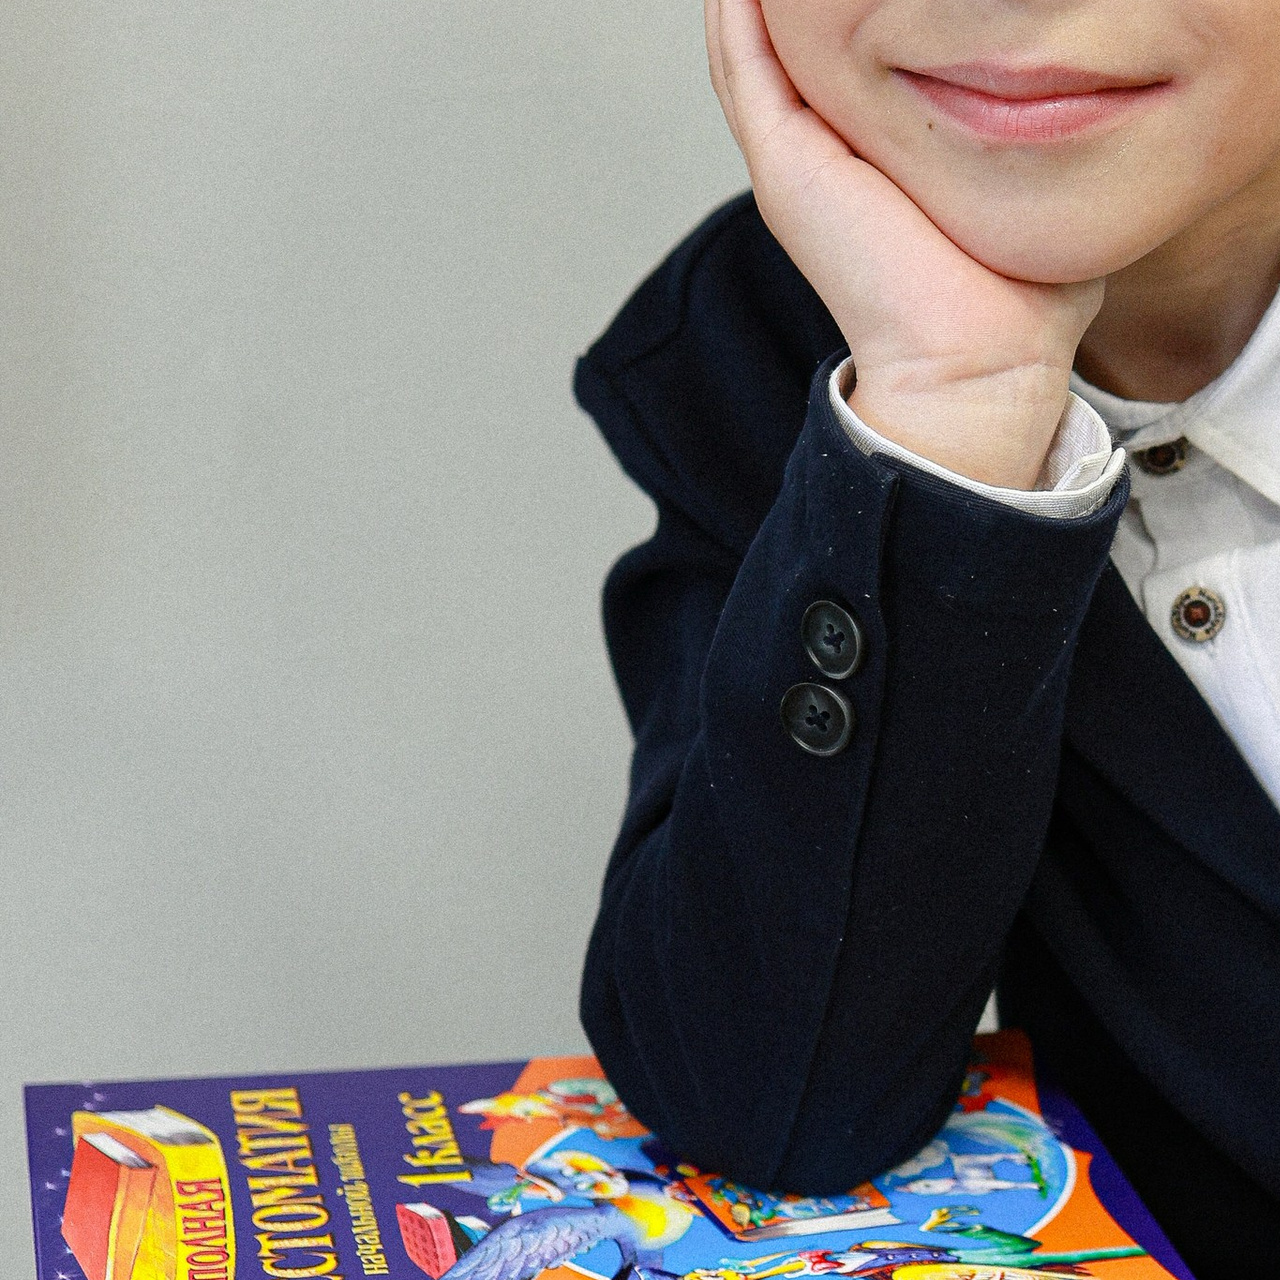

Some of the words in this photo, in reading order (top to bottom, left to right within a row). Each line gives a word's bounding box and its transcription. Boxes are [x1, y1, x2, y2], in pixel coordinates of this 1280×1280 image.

[397, 1090, 464, 1168] класс
[396, 1170, 473, 1188] 1
[336, 1179, 389, 1276] начальной
